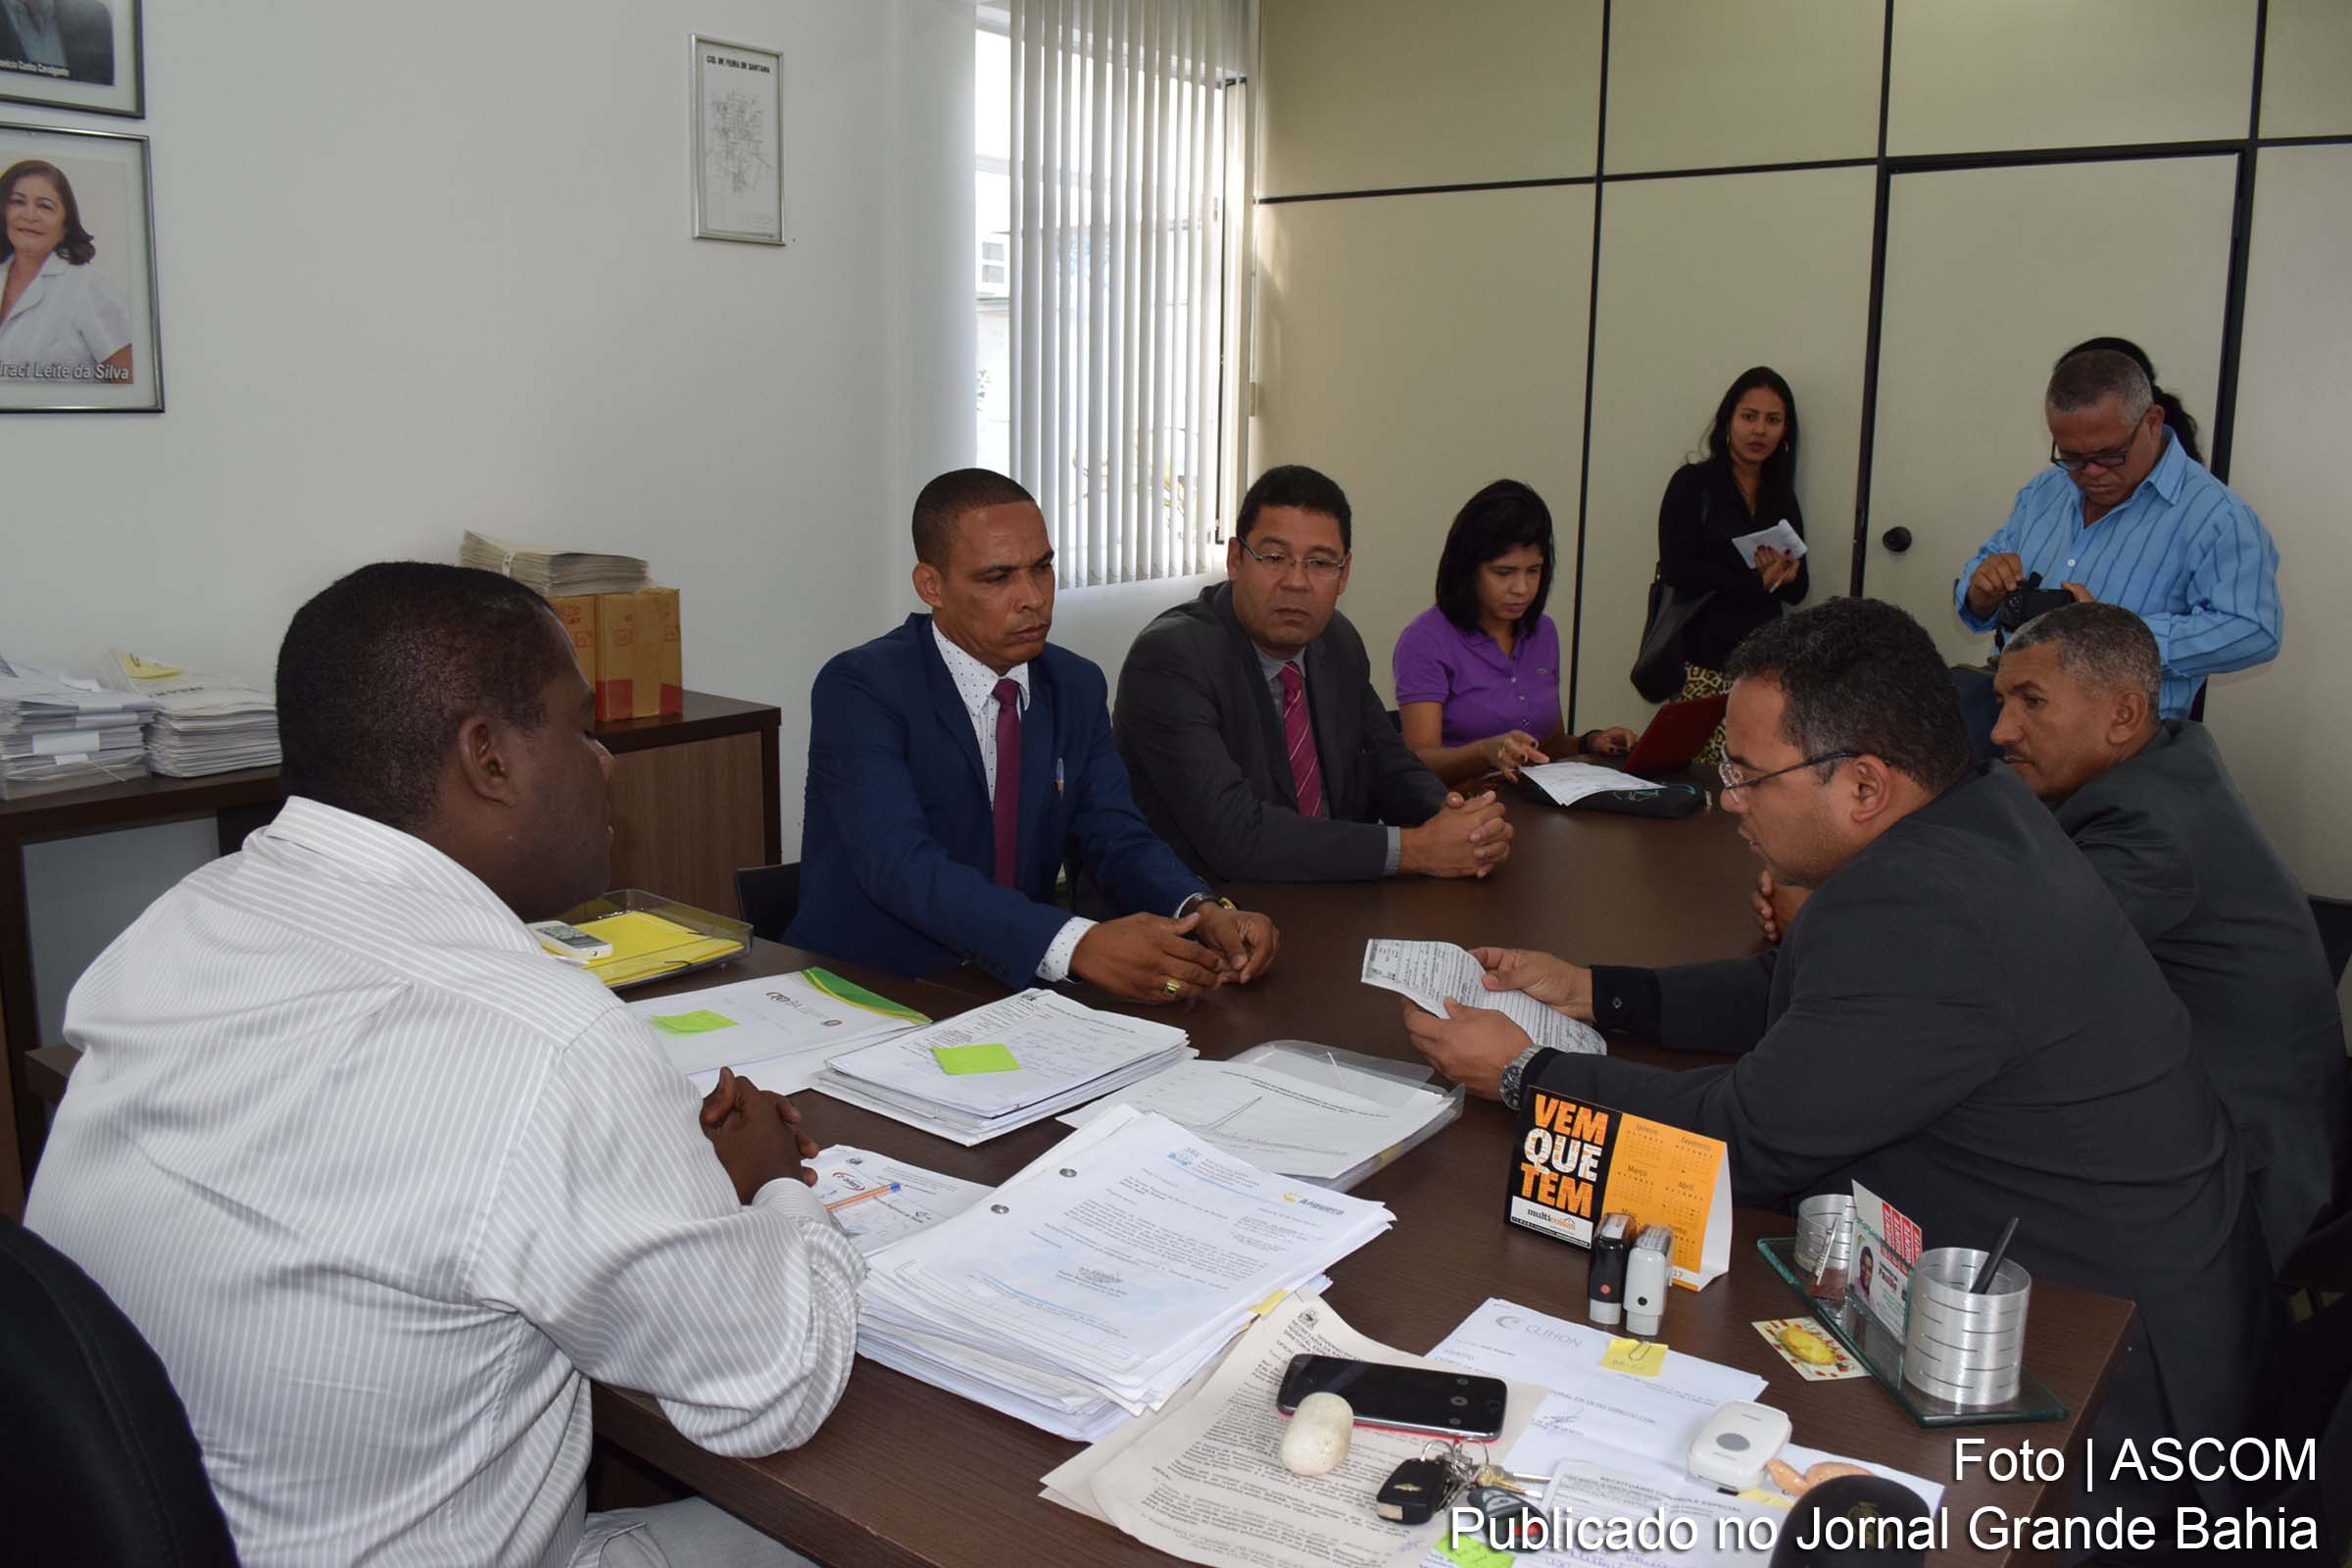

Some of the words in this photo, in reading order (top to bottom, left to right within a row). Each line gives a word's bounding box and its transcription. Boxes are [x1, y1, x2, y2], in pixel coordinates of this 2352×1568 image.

[33, 363, 72, 378] Leite
[74, 364, 90, 379] da
[95, 364, 129, 380] Silva
[1535, 1094, 1609, 1146] VEM
[1524, 1127, 1603, 1182] QUE
[1520, 1162, 1593, 1218] TEM
